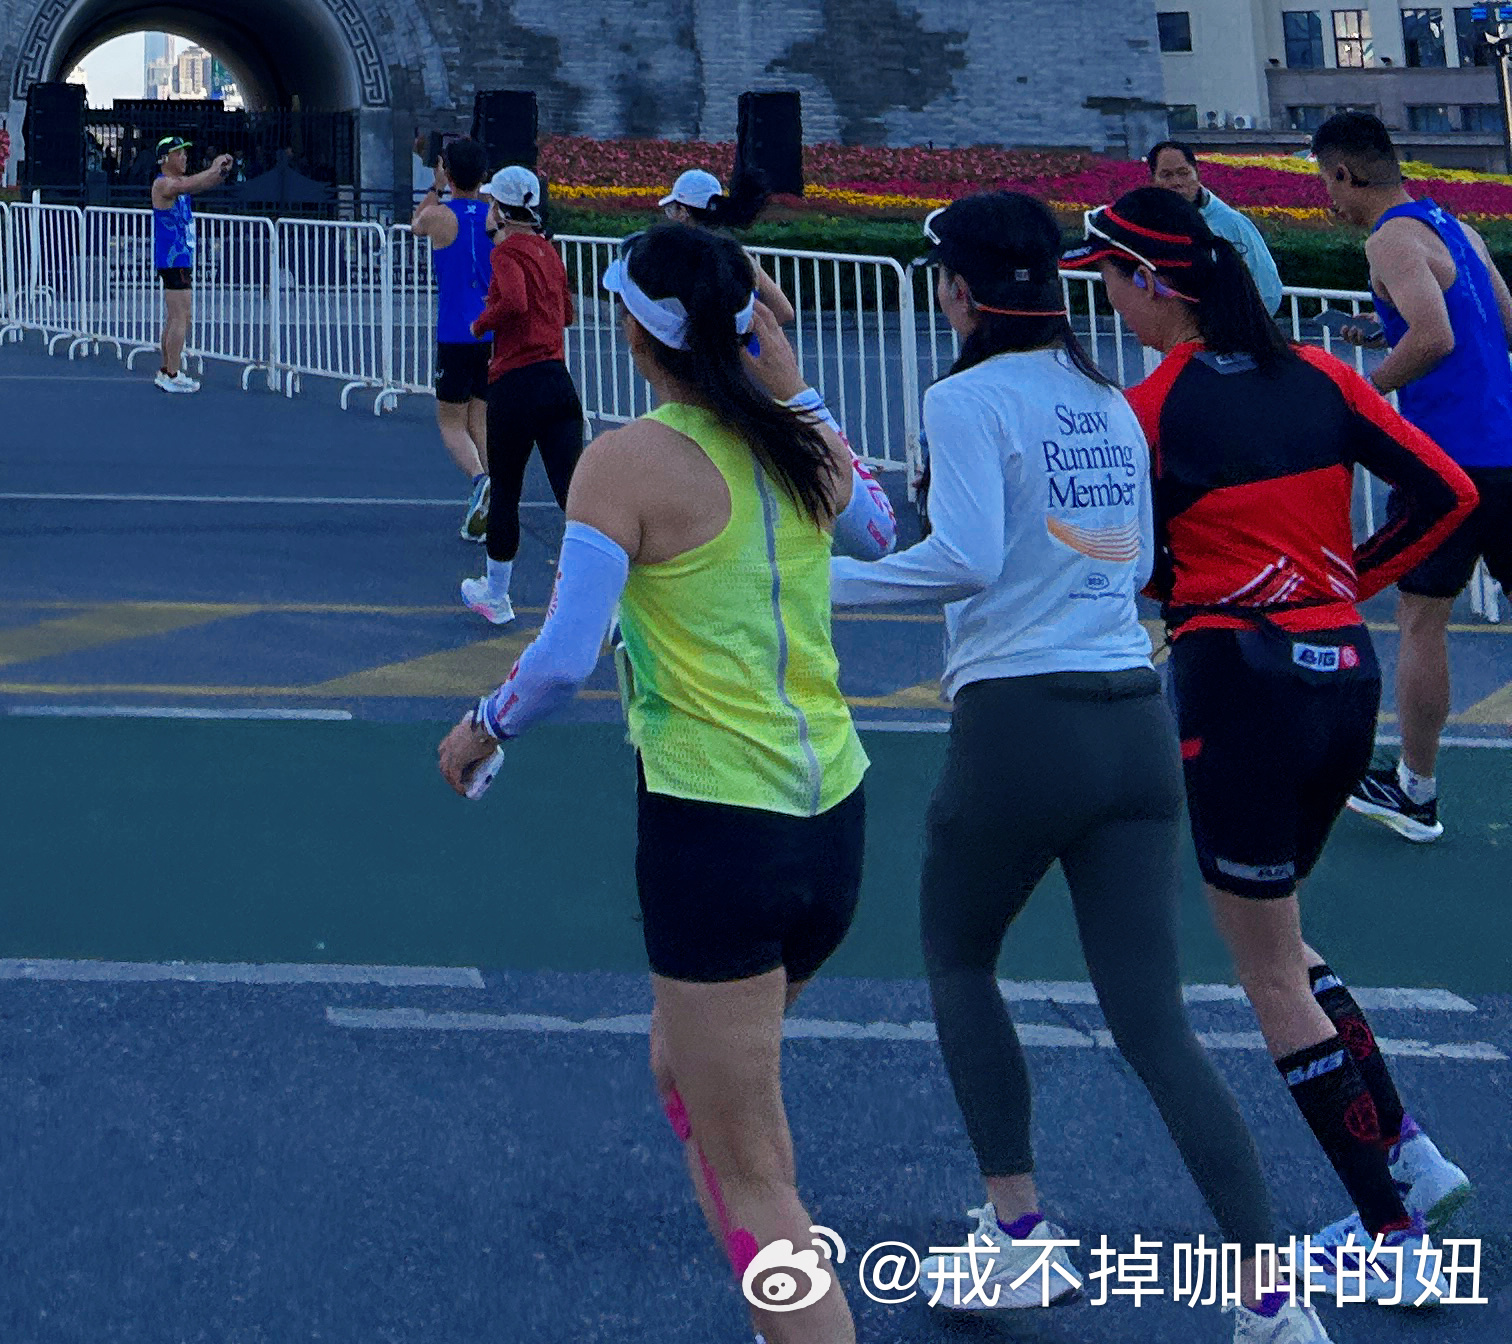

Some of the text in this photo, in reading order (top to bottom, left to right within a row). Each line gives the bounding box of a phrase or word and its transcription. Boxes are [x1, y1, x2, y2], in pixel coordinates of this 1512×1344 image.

[1055, 404, 1108, 436] Staw
[1043, 438, 1136, 477] Running
[1047, 472, 1136, 508] Member
